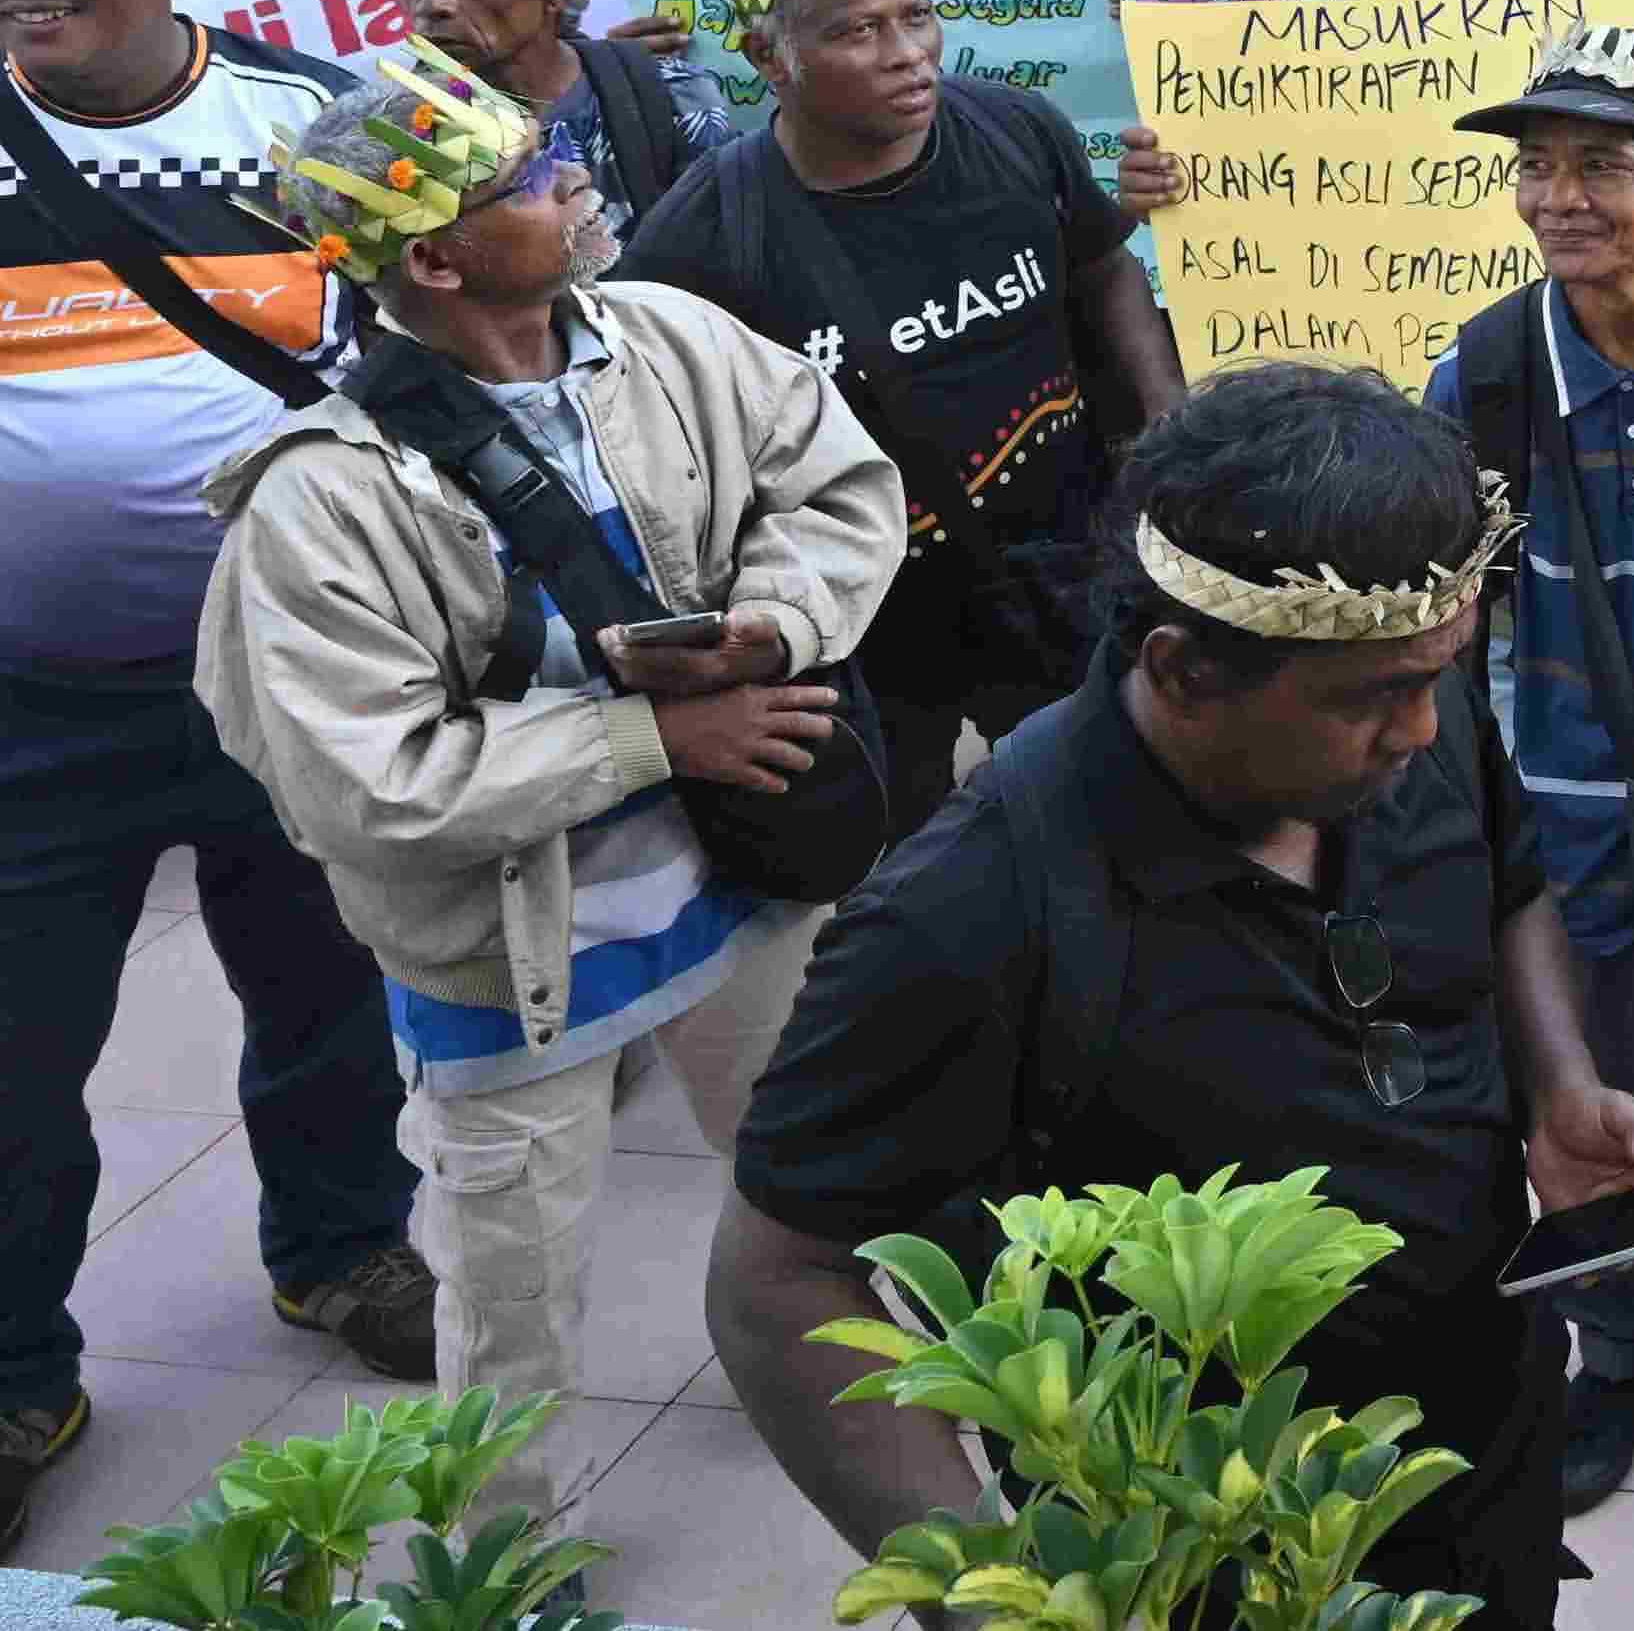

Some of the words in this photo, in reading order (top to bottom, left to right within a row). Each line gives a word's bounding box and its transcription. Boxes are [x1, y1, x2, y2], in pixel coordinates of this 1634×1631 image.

[1156, 41, 1479, 117] PENGIKTIRAFAN
[1316, 155, 1392, 206] ASLI
[1181, 237, 1277, 282] ASAL
[1307, 241, 1338, 290] DI
[1397, 314, 1458, 366] PE
